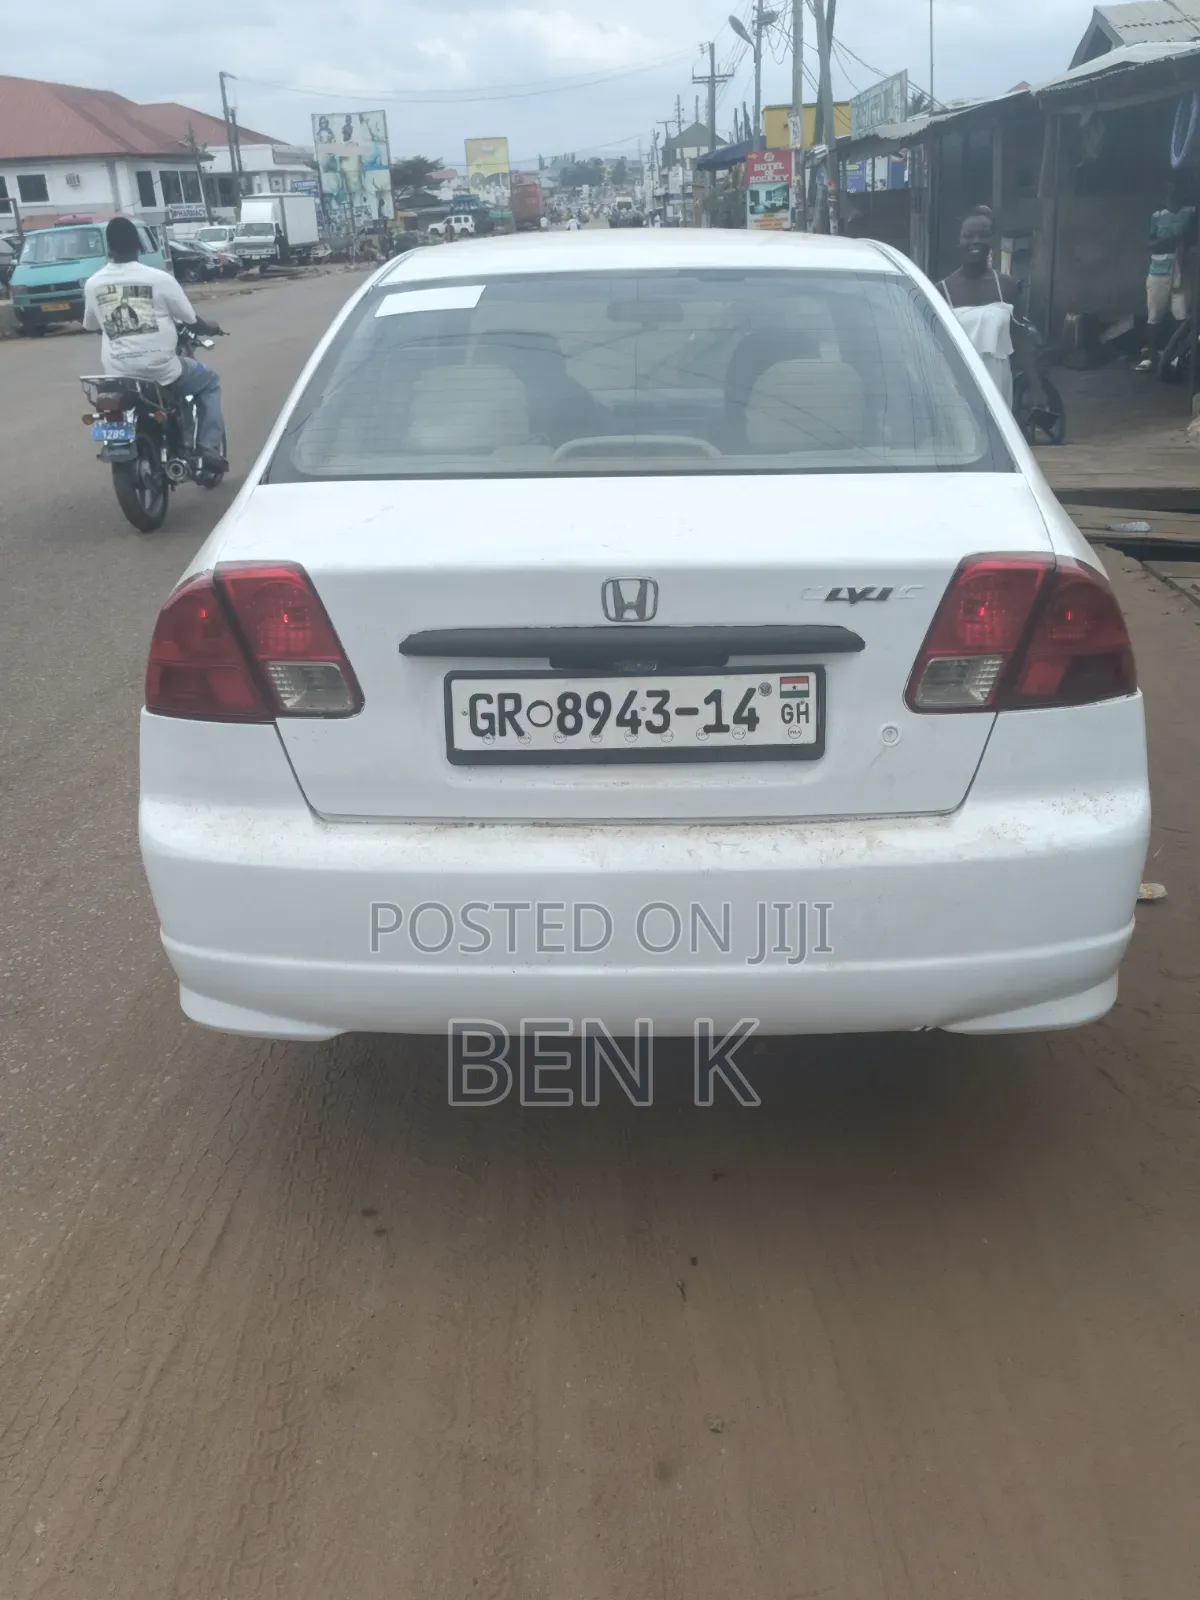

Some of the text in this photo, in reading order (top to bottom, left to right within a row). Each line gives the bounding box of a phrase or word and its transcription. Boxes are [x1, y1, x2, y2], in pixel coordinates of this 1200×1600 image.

[754, 162, 784, 171] HOTEL
[176, 208, 206, 217] PHARMACY
[557, 688, 760, 736] 8943-14
[781, 702, 809, 724] GH
